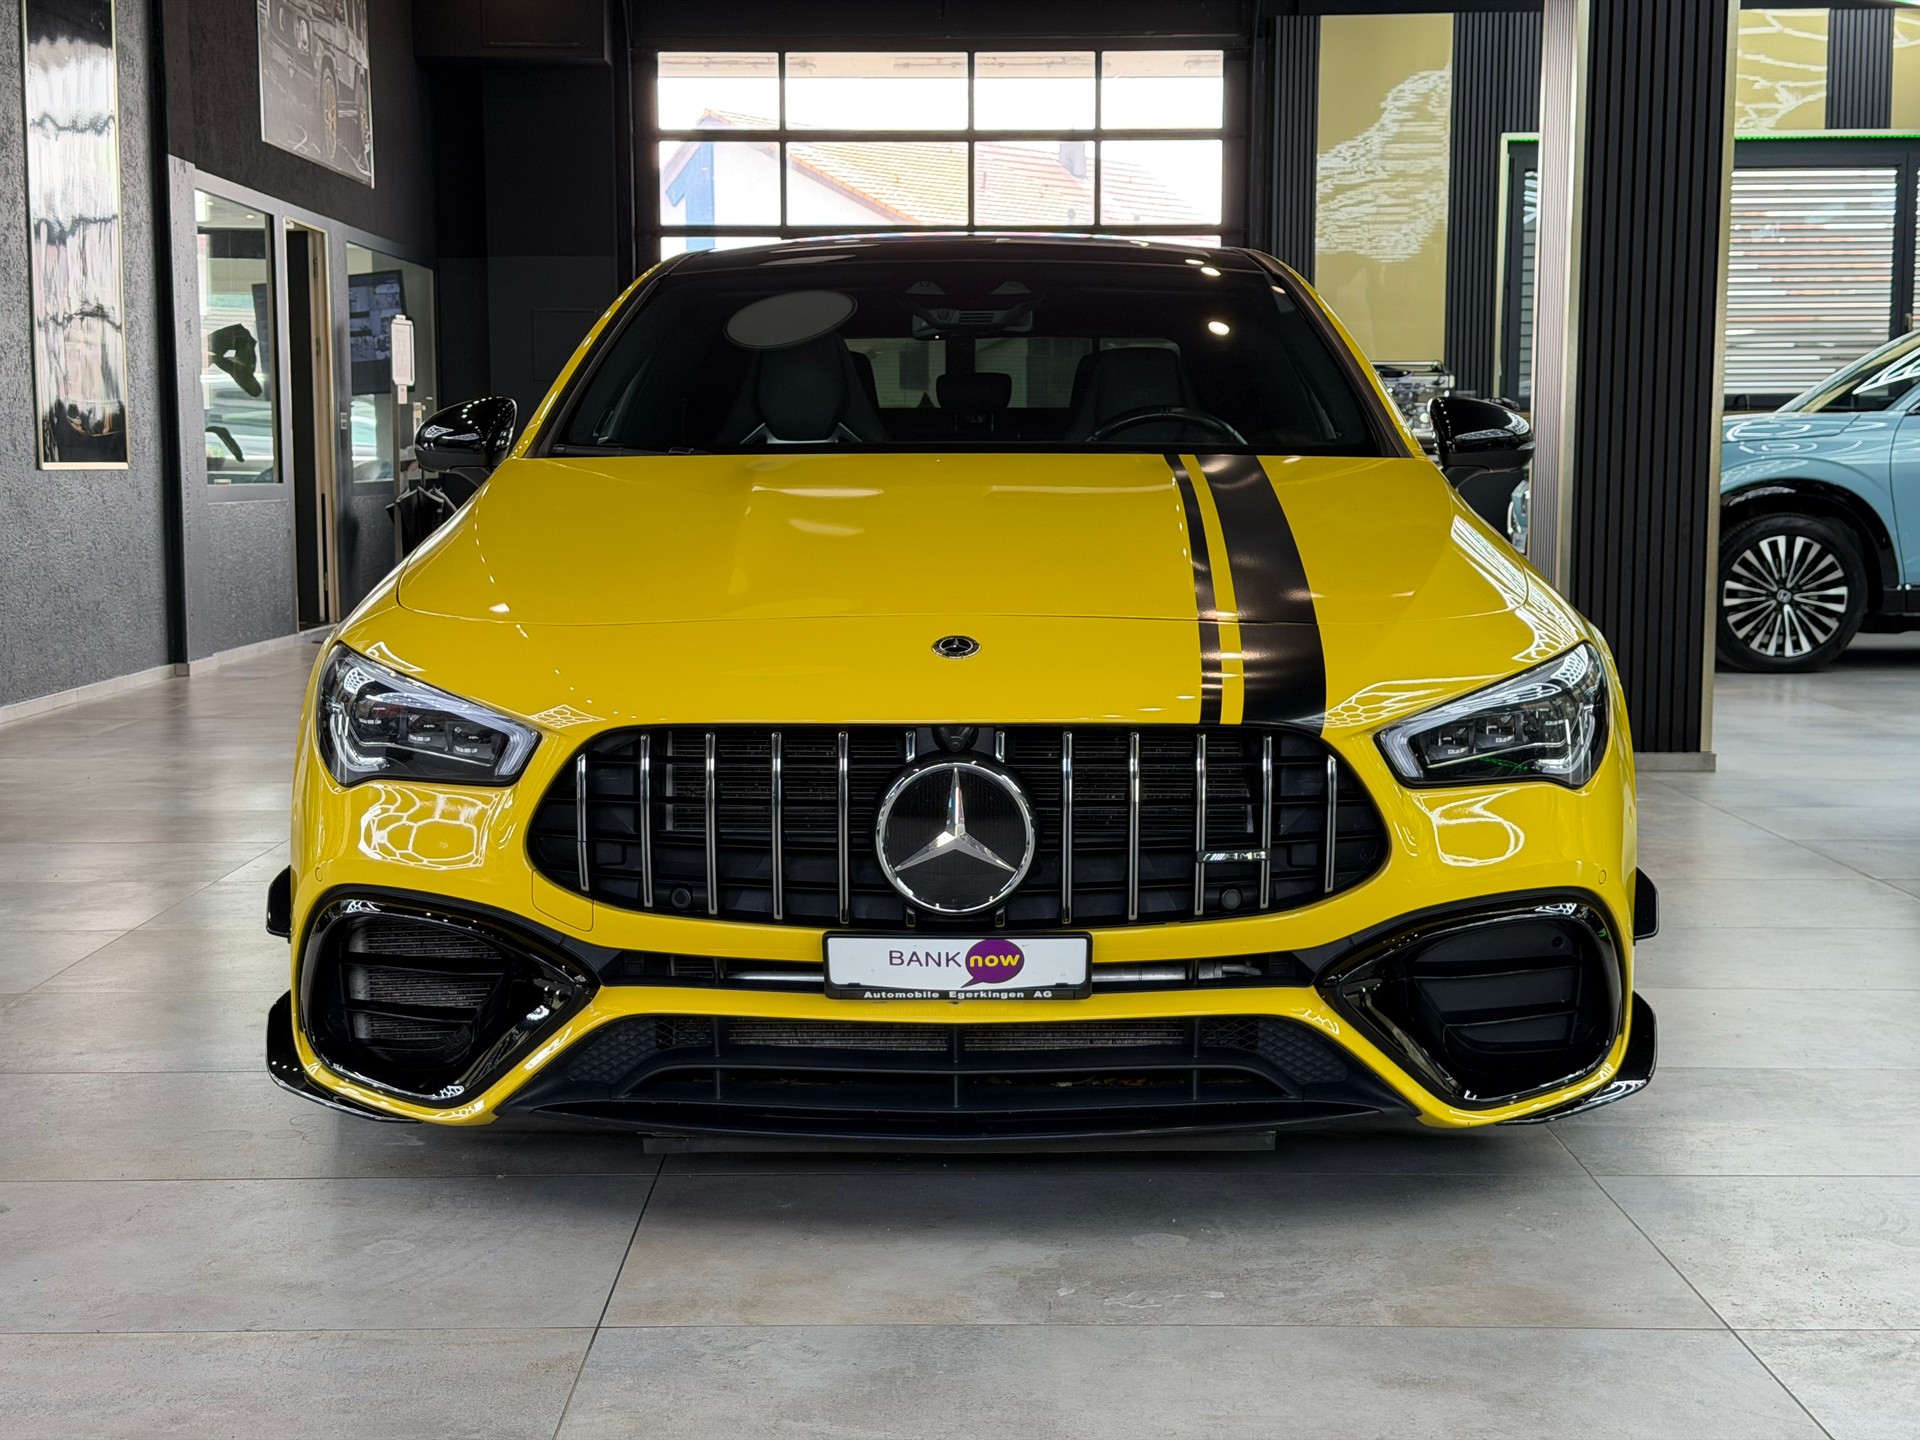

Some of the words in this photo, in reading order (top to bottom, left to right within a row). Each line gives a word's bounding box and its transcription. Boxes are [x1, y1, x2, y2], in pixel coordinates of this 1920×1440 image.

[888, 950, 961, 967] BANK
[969, 953, 1020, 967] now
[863, 990, 940, 999] Automobile
[949, 990, 1025, 999] Egerkingen
[1033, 990, 1053, 999] AG
